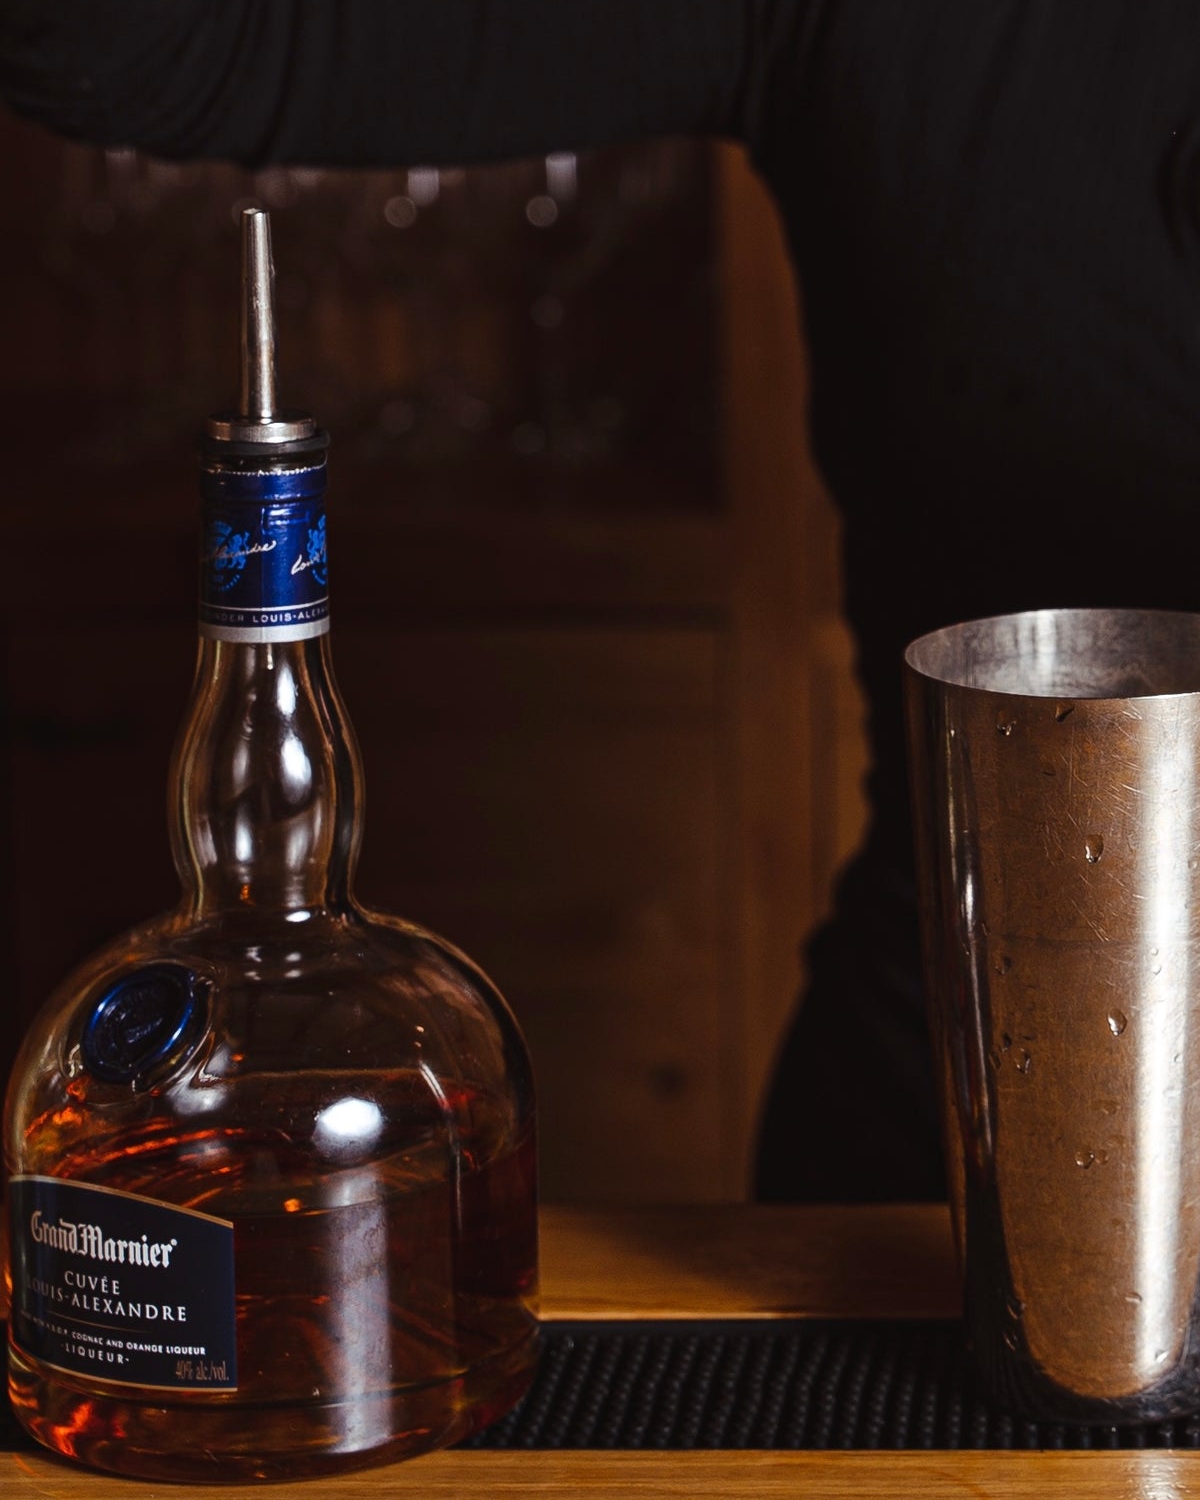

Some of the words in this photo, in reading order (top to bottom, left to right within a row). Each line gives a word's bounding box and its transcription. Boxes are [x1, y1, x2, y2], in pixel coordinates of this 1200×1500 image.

[30, 1210, 78, 1254] Grand
[78, 1223, 174, 1268] Marnier
[26, 1278, 188, 1322] LOUIS-ALEXANDRE
[71, 1331, 104, 1346] COGNAC
[106, 1338, 124, 1349] AND
[126, 1341, 163, 1354] ORANGE
[166, 1345, 207, 1356] LIQUEUR
